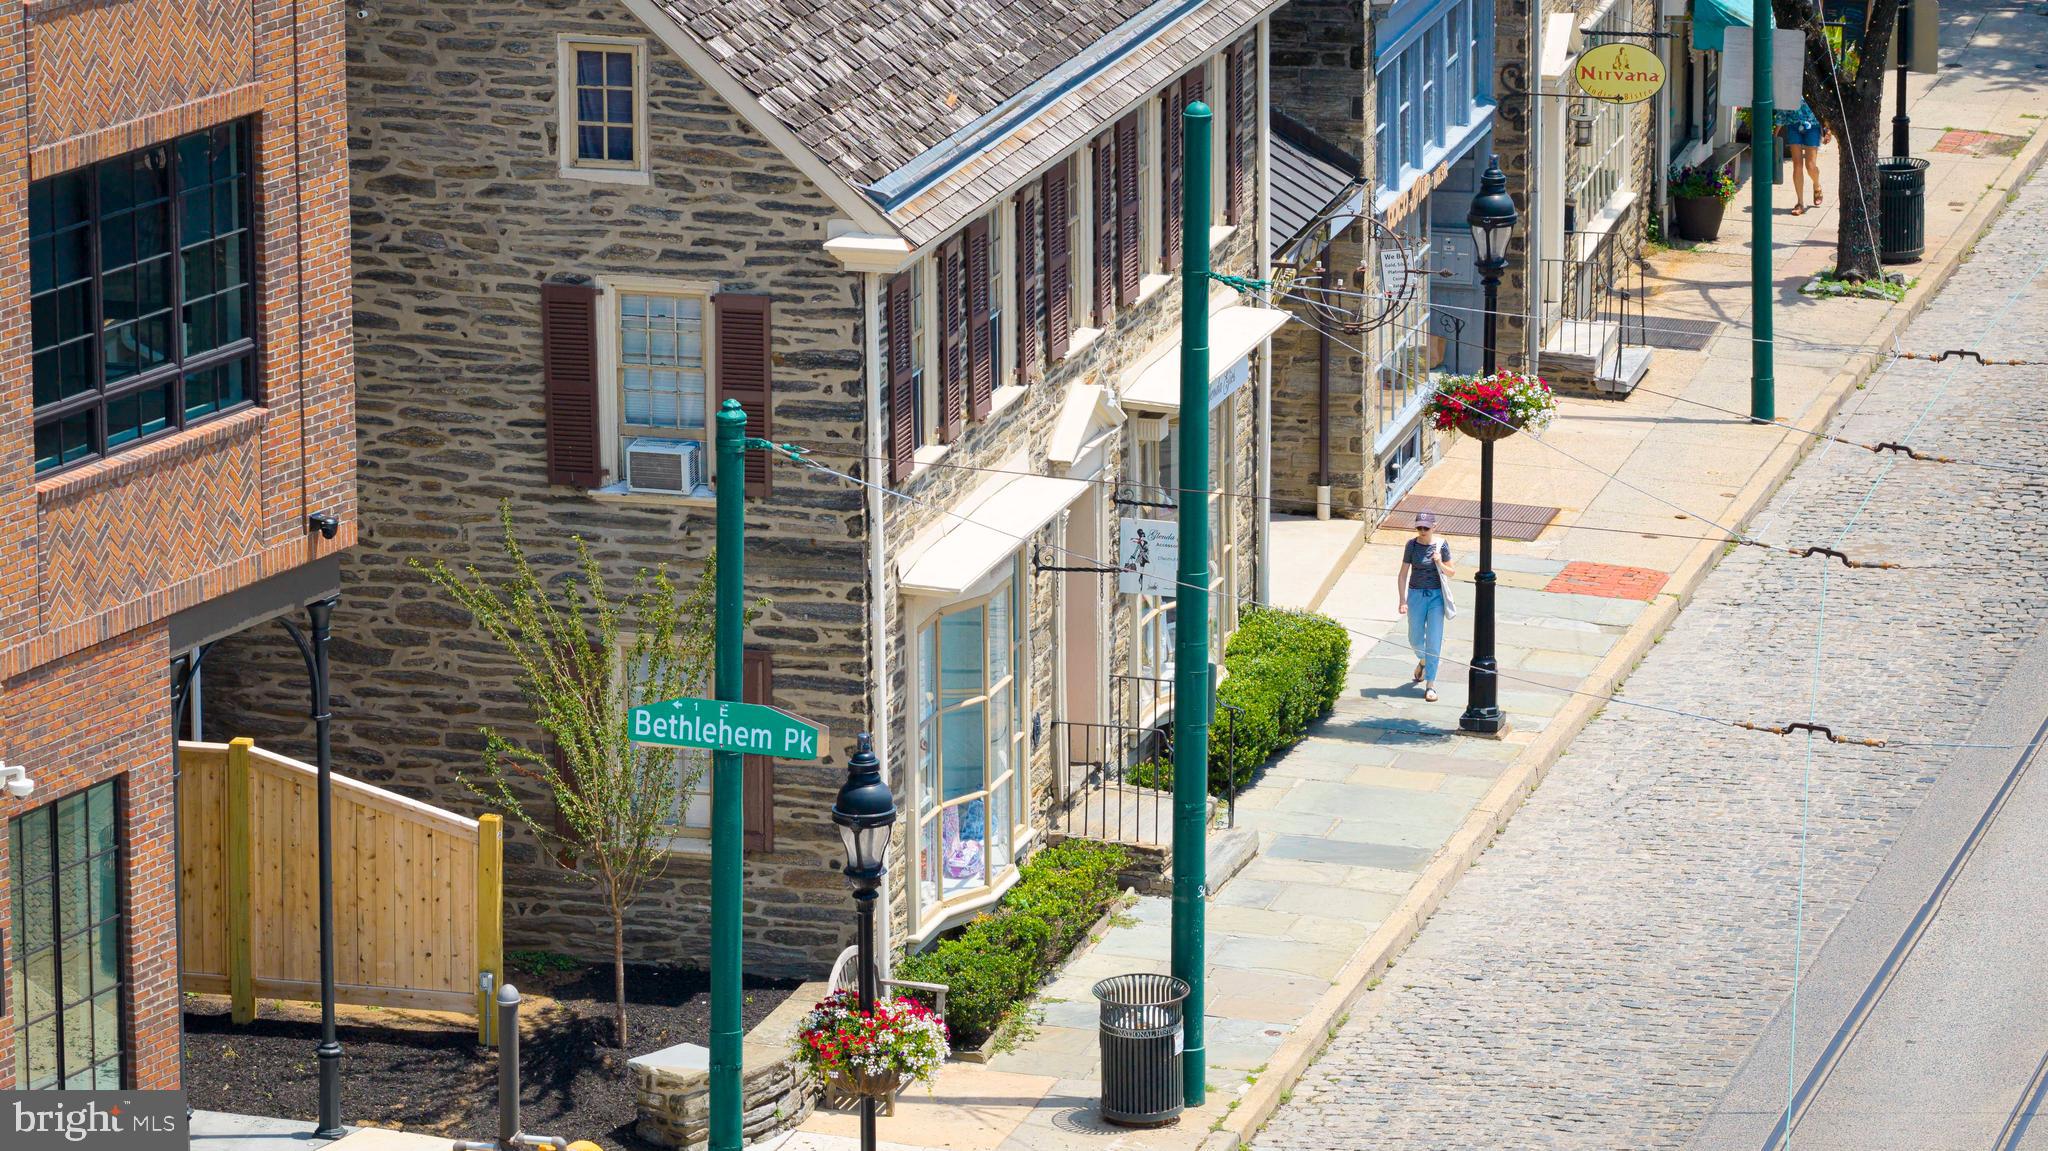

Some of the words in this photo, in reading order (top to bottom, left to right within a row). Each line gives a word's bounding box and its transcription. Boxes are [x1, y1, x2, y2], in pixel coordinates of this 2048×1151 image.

[1580, 65, 1660, 82] Nirvana
[1396, 252, 1409, 260] By
[1147, 529, 1175, 540] Glenda
[694, 702, 698, 711] 1
[719, 704, 728, 717] E
[635, 709, 772, 750] Bethlehem
[785, 728, 812, 754] Pk
